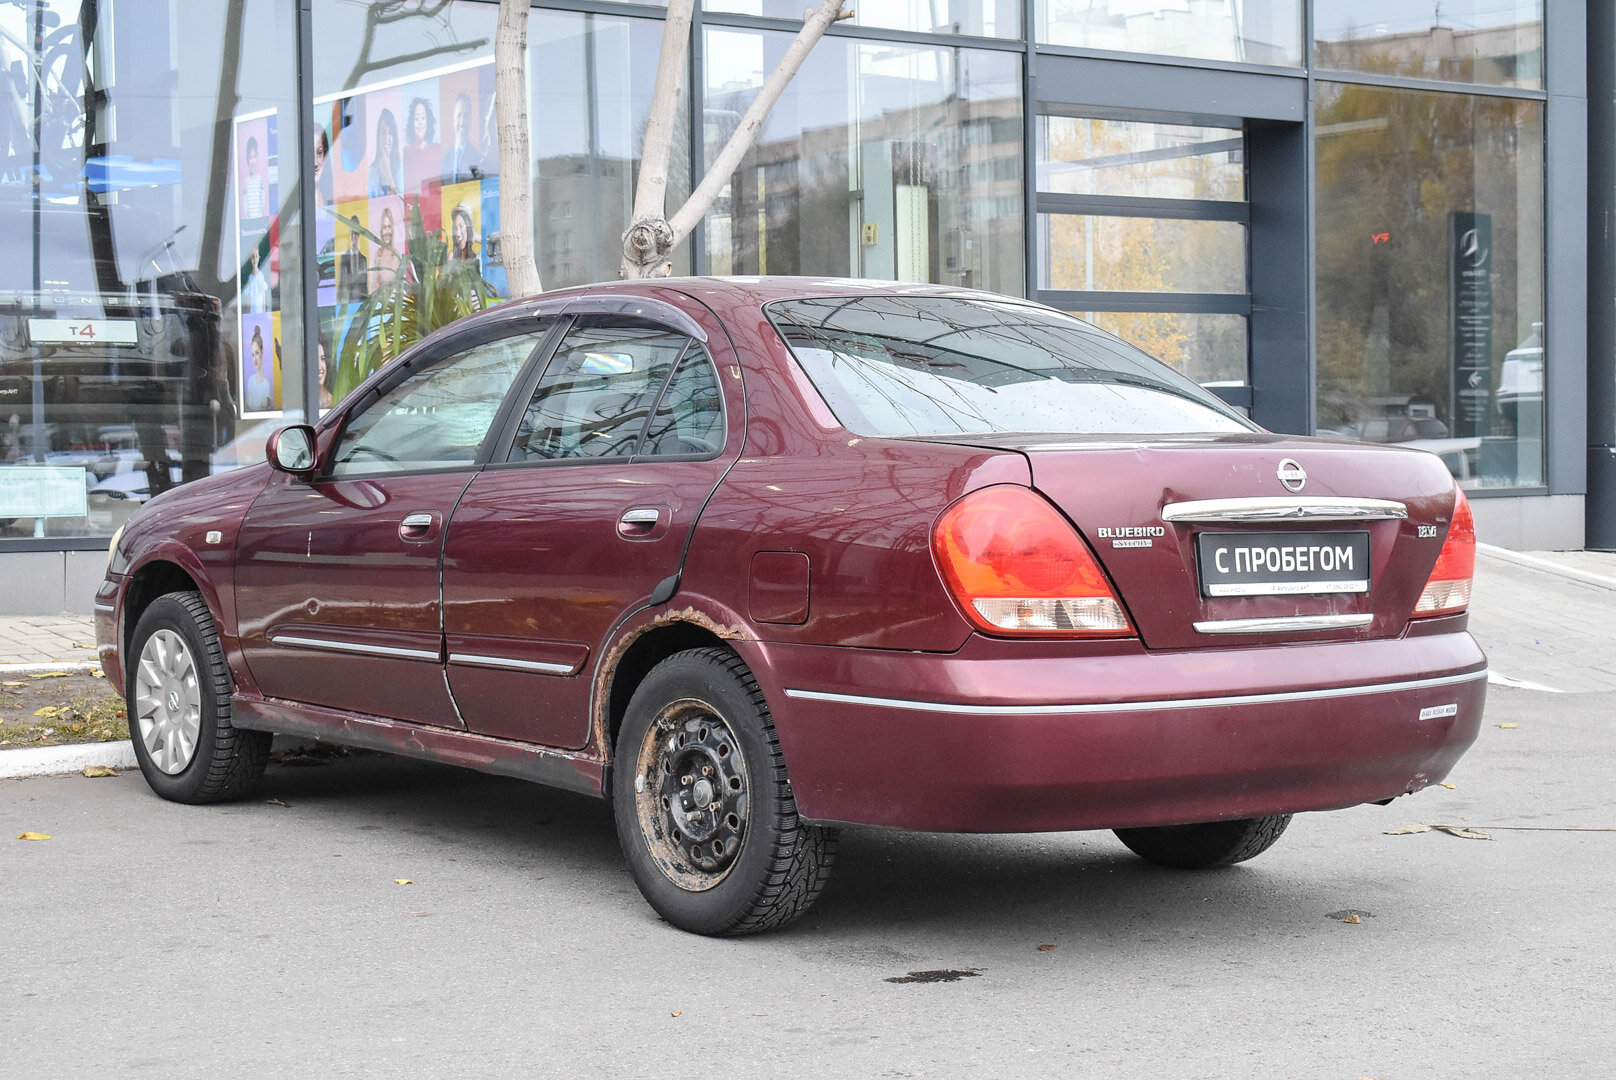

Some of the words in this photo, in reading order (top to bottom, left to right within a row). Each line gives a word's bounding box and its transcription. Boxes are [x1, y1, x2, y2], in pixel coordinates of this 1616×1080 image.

[69, 324, 95, 338] T4
[1097, 526, 1165, 538] BLUEBIRD
[1215, 548, 1229, 573] С
[1235, 546, 1354, 573] ПРОБЕГОМ
